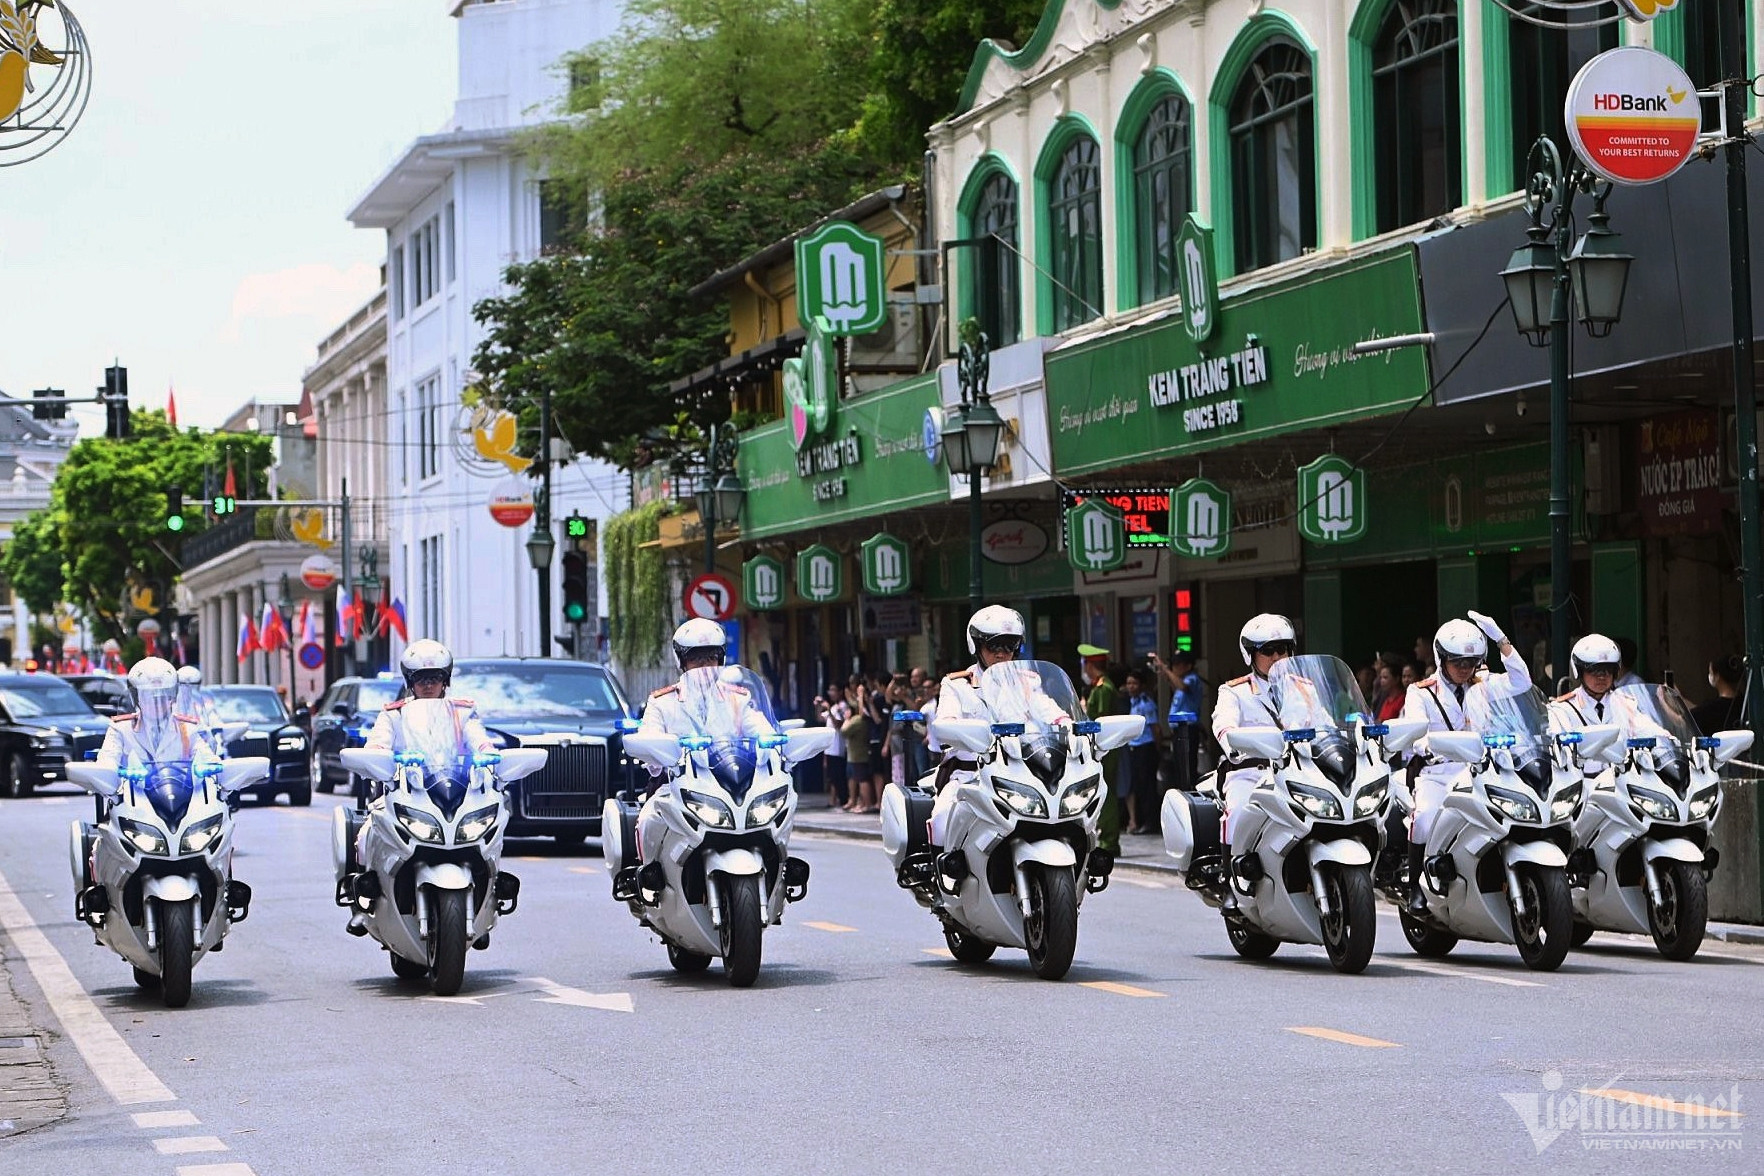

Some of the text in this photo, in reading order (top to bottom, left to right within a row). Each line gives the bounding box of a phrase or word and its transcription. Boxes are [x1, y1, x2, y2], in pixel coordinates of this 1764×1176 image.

[1594, 93, 1667, 111] HDBank
[1608, 136, 1670, 145] COMMITTED TO
[1599, 148, 1680, 158] YOUR BEST RETURNS
[1148, 332, 1267, 408] KEM TRÀNG TIỀN
[1183, 399, 1239, 433] SINCE 1958
[1669, 454, 1682, 492] ÉP
[214, 497, 235, 514] 31
[1135, 496, 1169, 511] TIEN
[568, 520, 586, 536] 30
